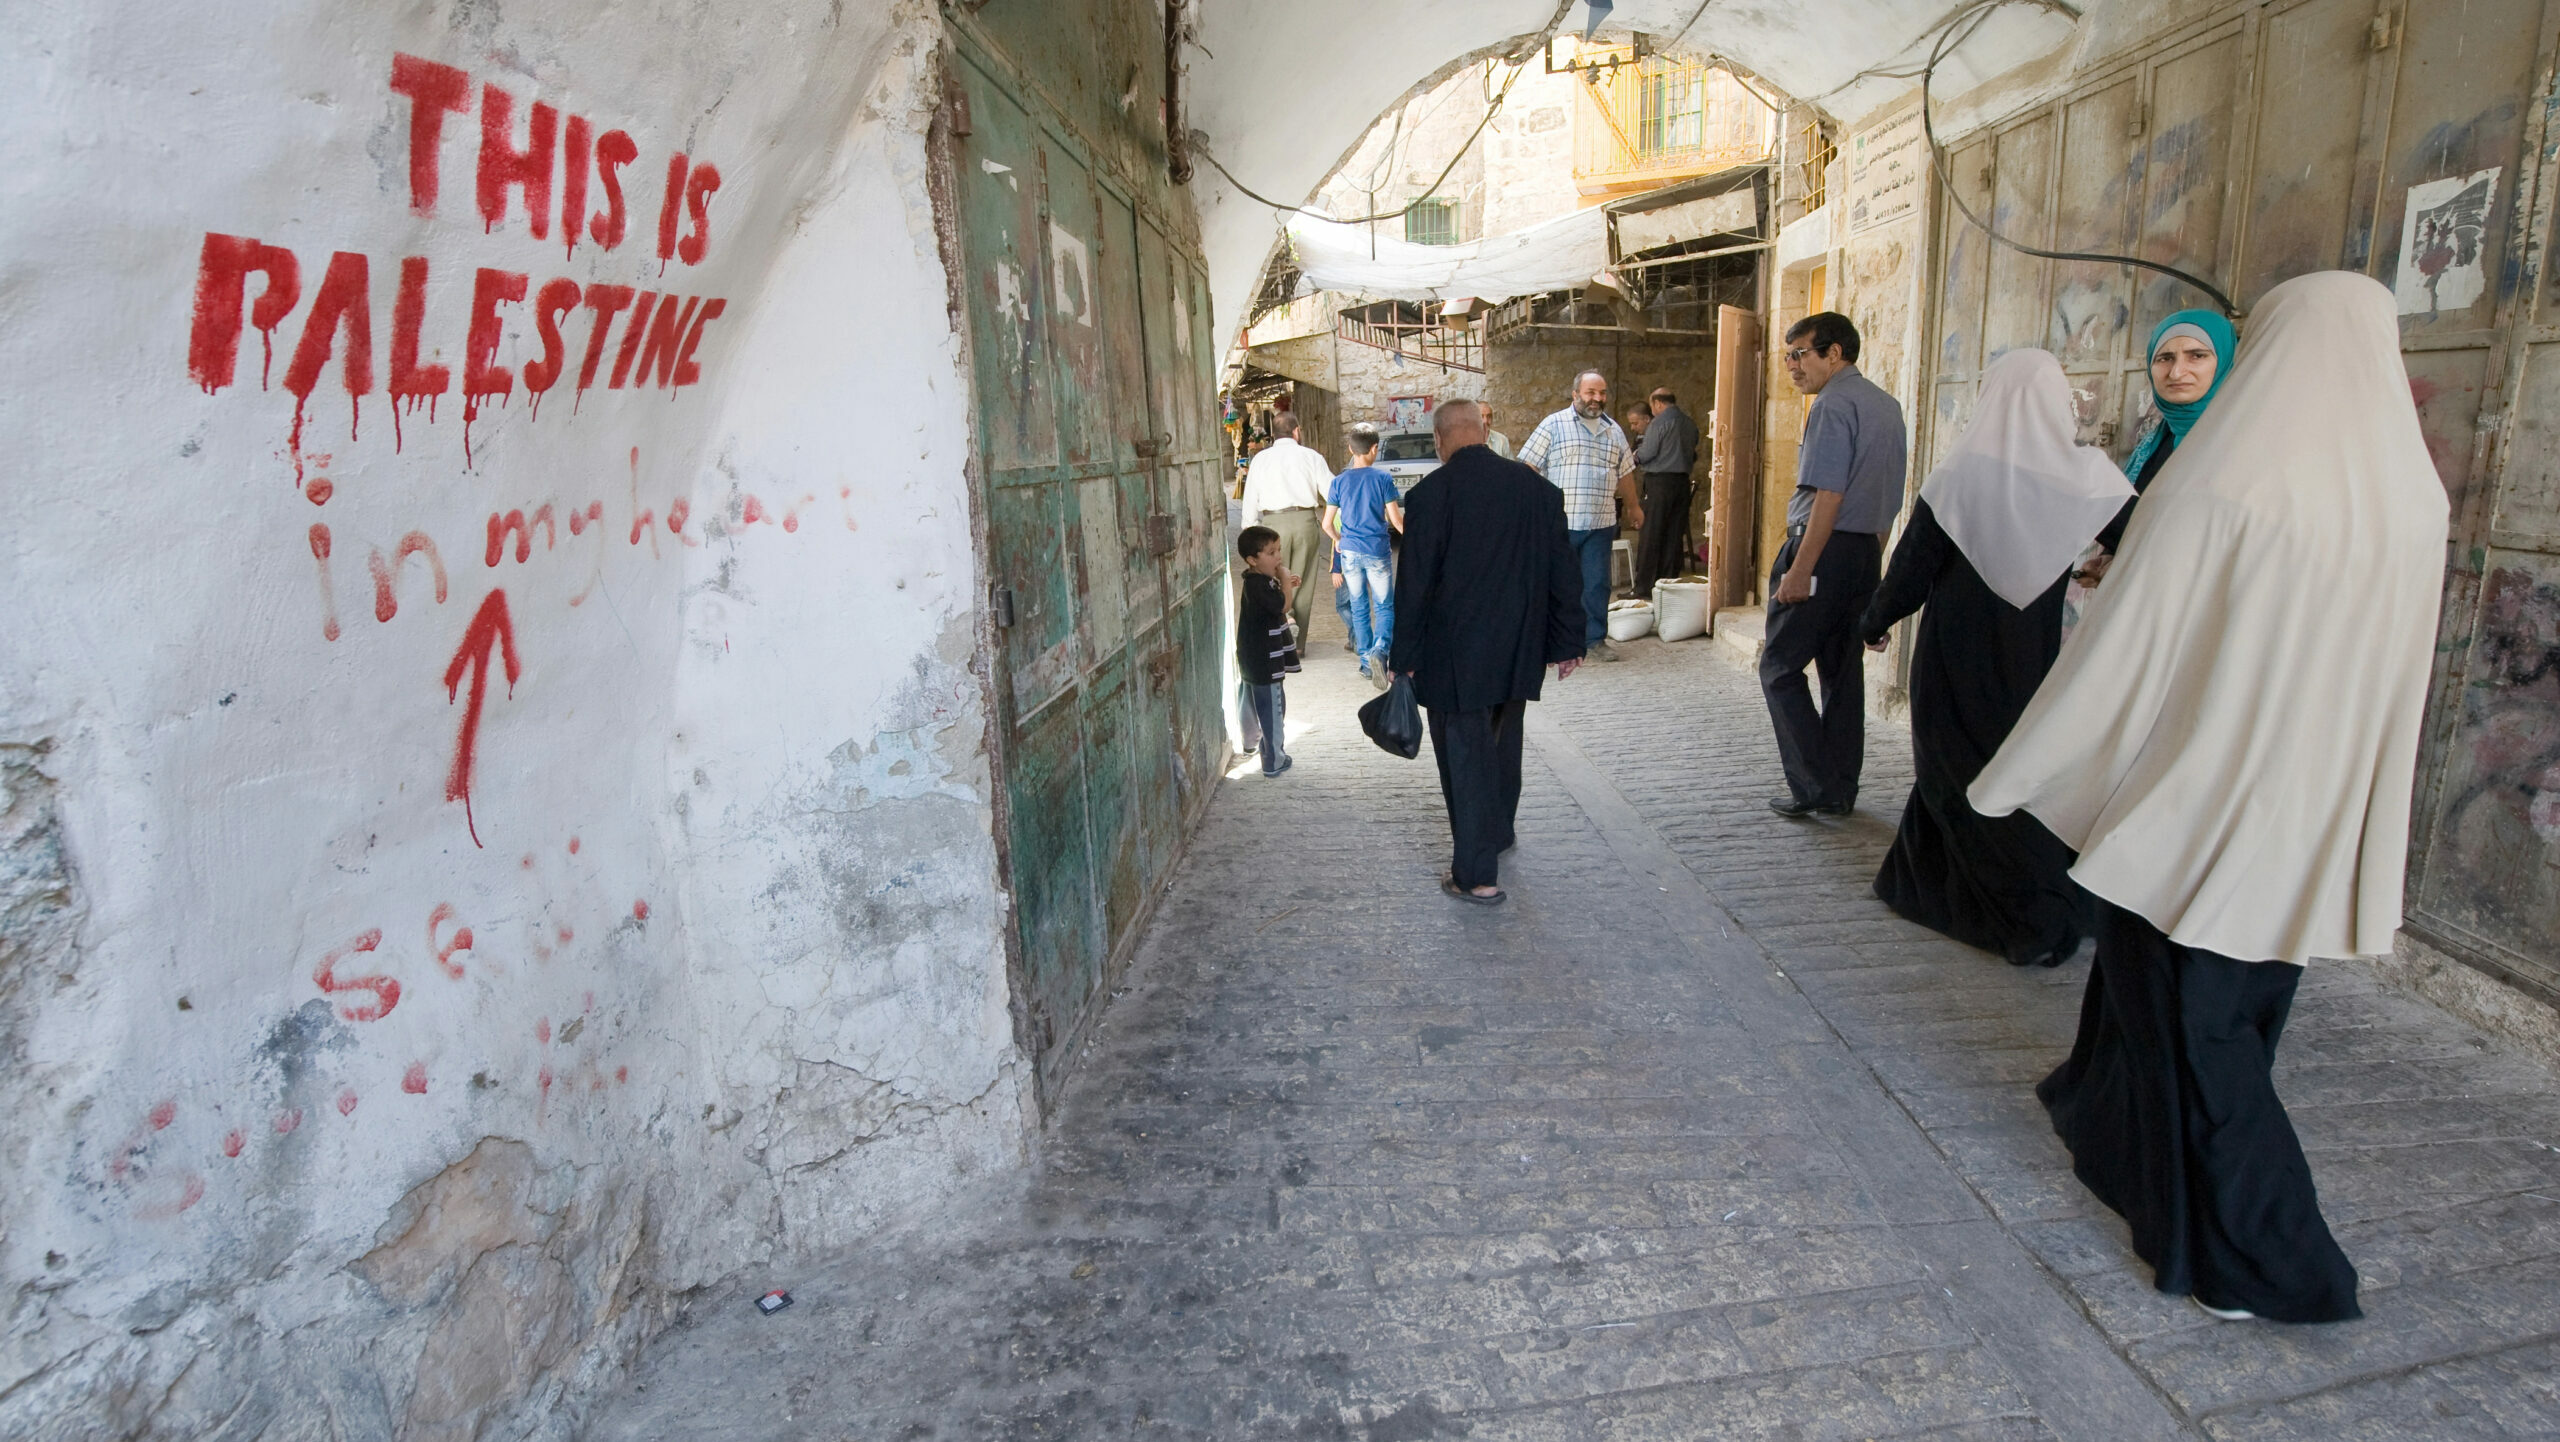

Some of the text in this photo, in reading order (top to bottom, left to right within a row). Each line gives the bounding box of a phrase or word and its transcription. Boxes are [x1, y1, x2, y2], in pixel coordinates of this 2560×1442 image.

[391, 52, 721, 268] THIS IS
[188, 233, 728, 400] PALESTINE
[305, 476, 448, 642] in
[484, 500, 603, 607] my
